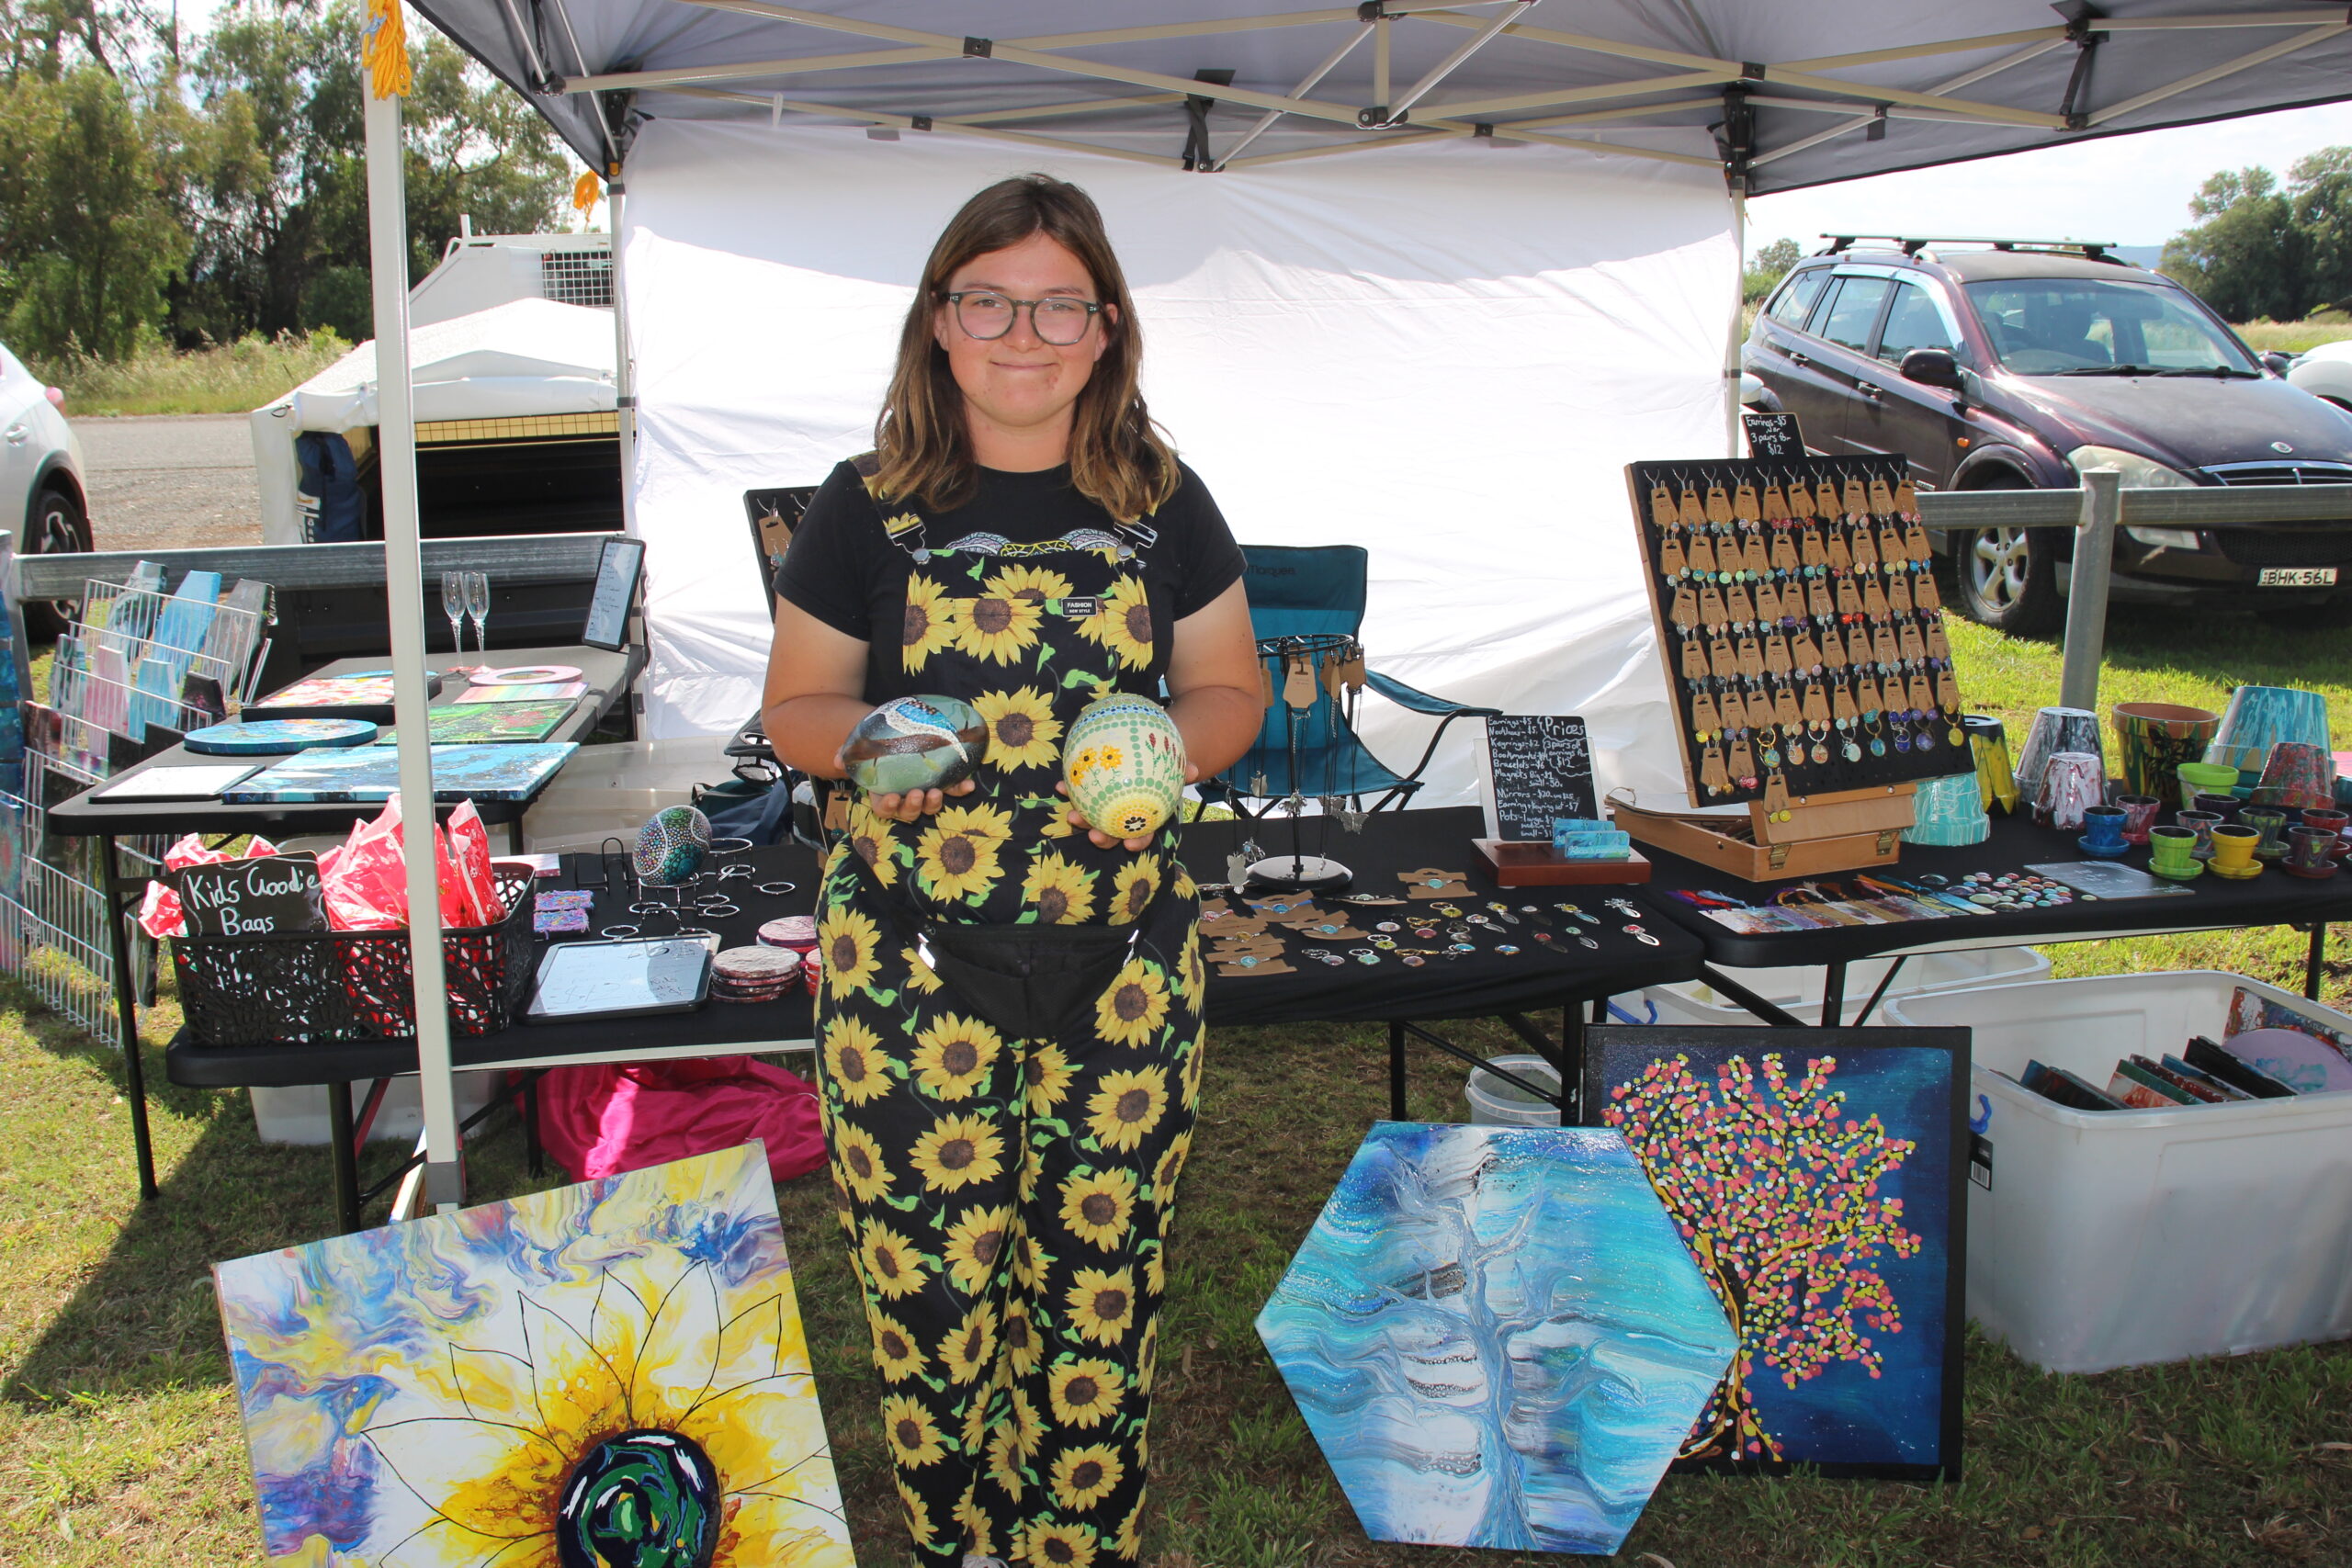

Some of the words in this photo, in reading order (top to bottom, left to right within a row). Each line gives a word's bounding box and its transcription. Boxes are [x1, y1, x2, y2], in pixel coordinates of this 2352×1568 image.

[1750, 434, 1757, 443] 3
[1758, 434, 1777, 445] pairs
[1768, 442, 1784, 456] $12
[1544, 716, 1585, 736] Prices
[1545, 740, 1551, 749] 3
[1553, 741, 1571, 750] pairs
[1557, 755, 1575, 768] $12
[1495, 769, 1528, 781] Magnets
[1497, 789, 1530, 798] Mirrors
[187, 874, 240, 909] Kids
[247, 866, 322, 897] Goodie
[220, 906, 275, 936] Bags
